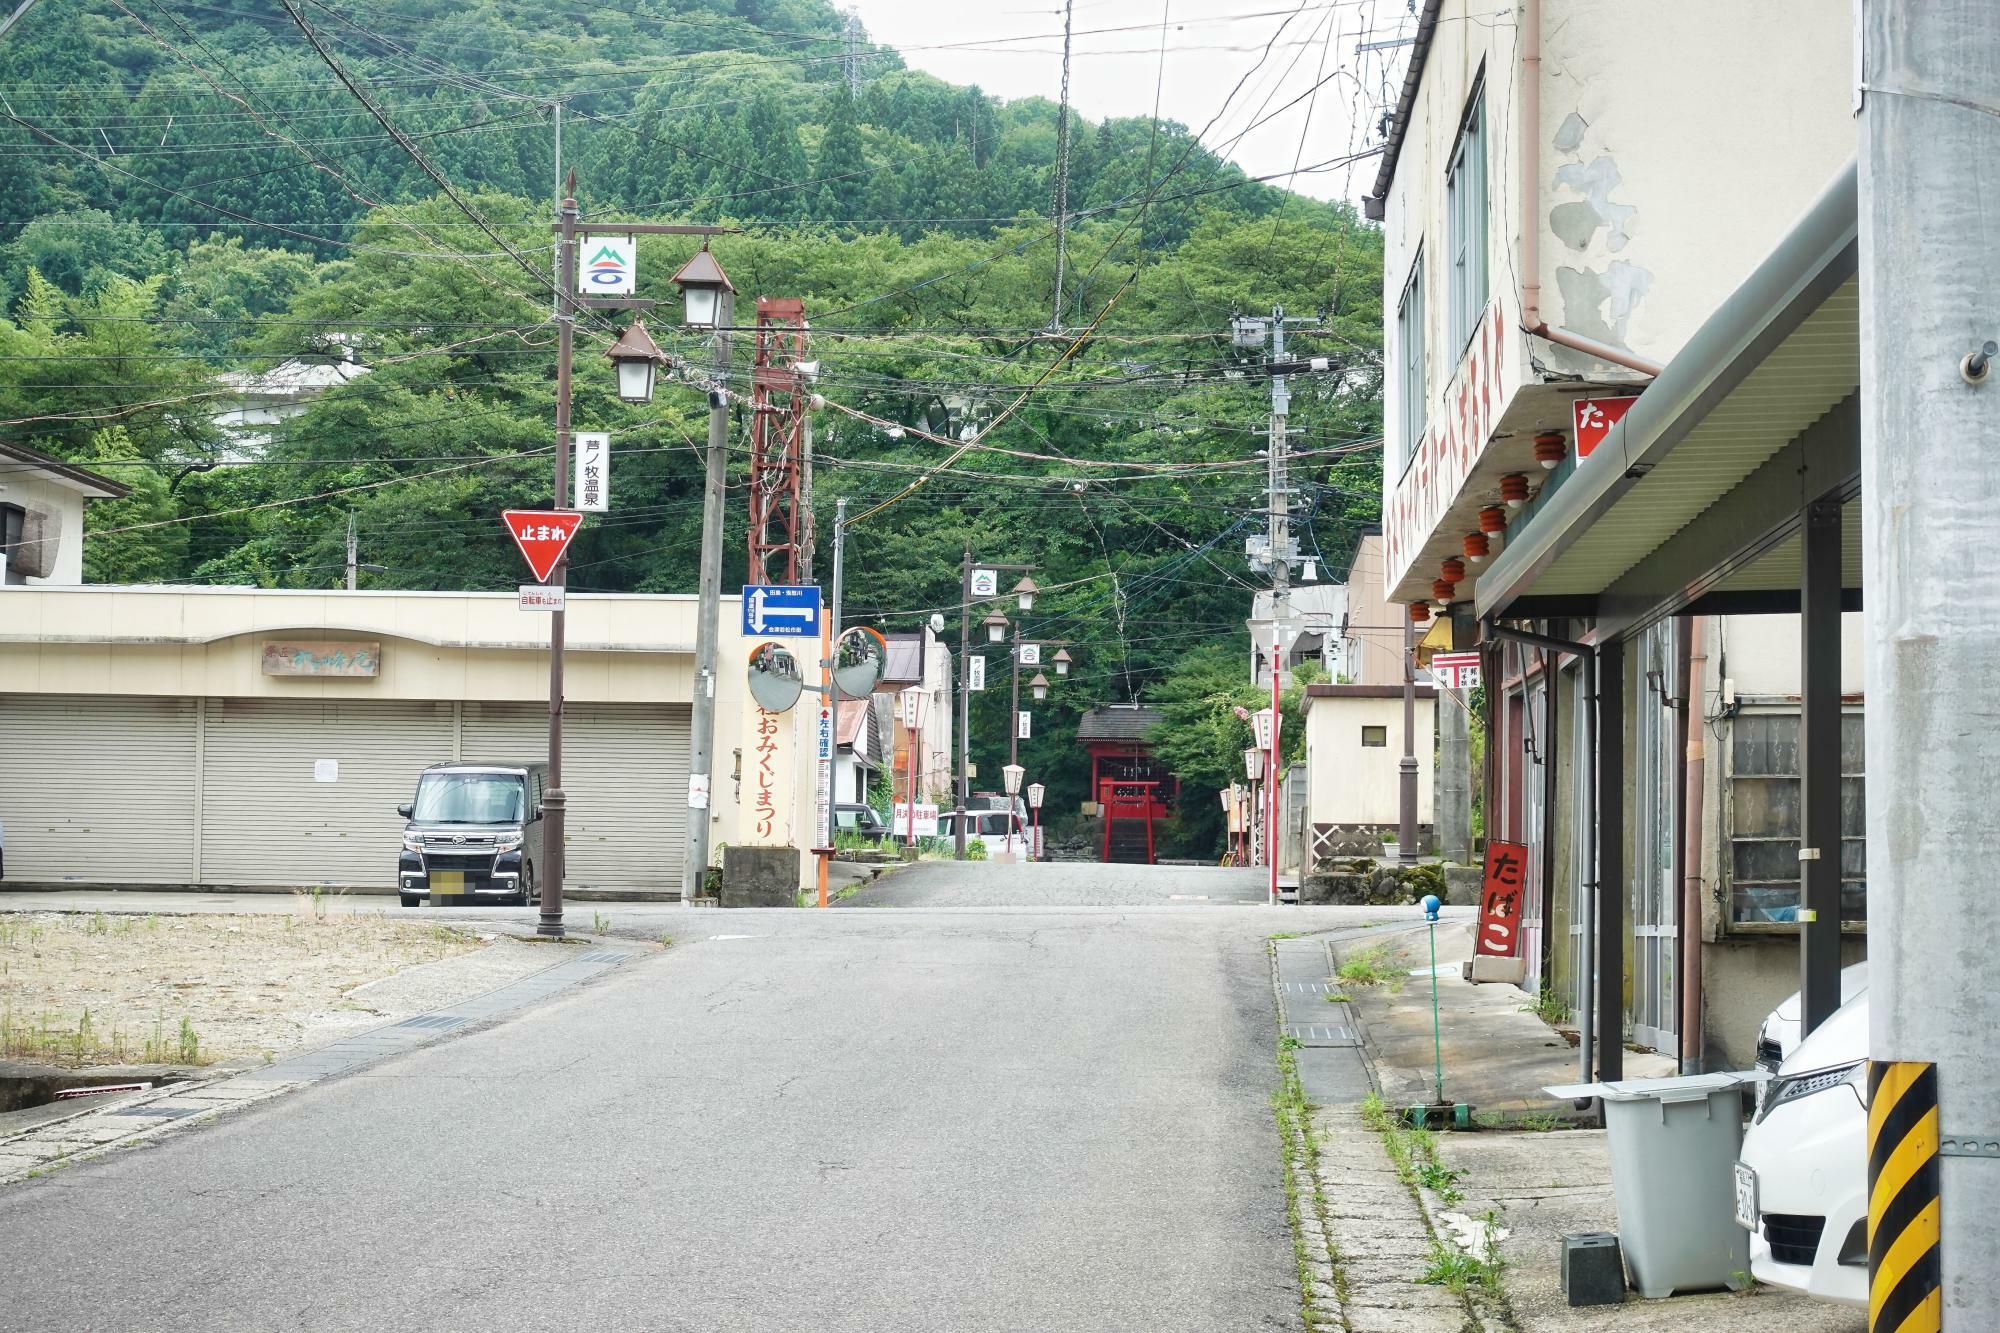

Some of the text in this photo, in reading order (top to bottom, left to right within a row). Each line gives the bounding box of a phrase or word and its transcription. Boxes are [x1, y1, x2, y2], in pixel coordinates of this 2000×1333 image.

[583, 440, 600, 506] 芦ノ牧温泉
[519, 524, 567, 541] 止まれ
[521, 596, 563, 605] 自転車も止まれ
[819, 719, 829, 757] 左右確認
[1484, 852, 1519, 952] たばこ
